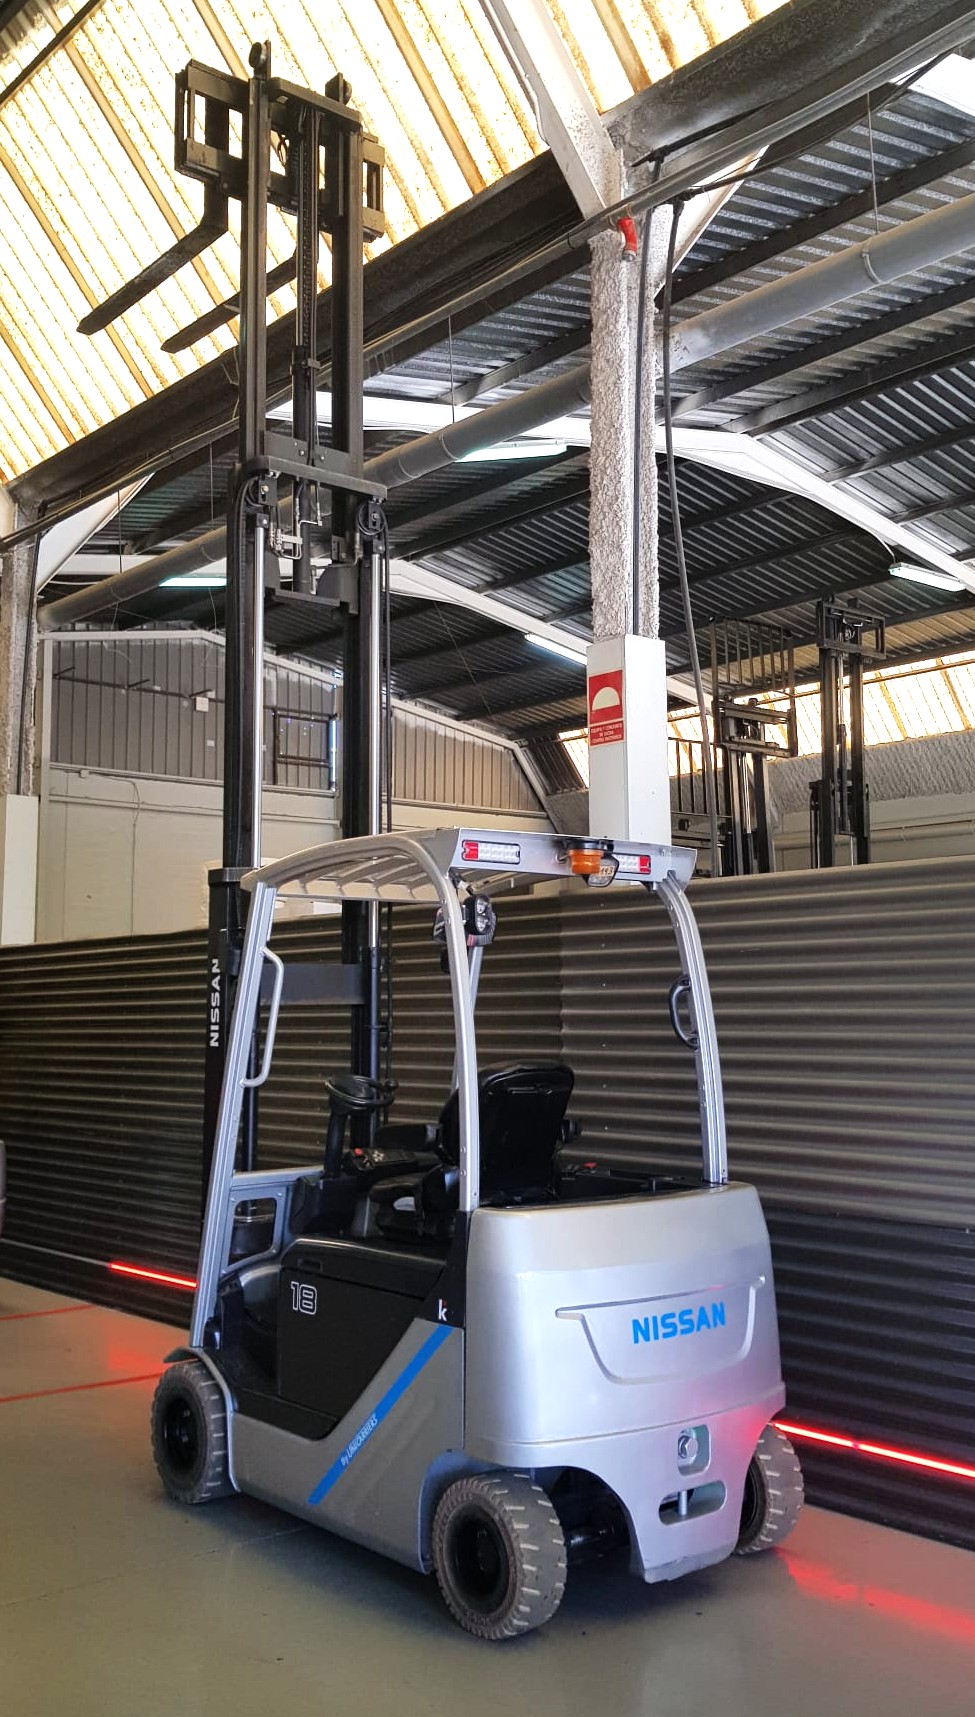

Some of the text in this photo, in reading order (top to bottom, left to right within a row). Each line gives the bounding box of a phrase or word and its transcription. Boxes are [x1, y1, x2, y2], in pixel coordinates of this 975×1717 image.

[209, 958, 221, 1048] NISSAN
[290, 1280, 318, 1315] 18
[632, 1302, 726, 1344] NISSAN
